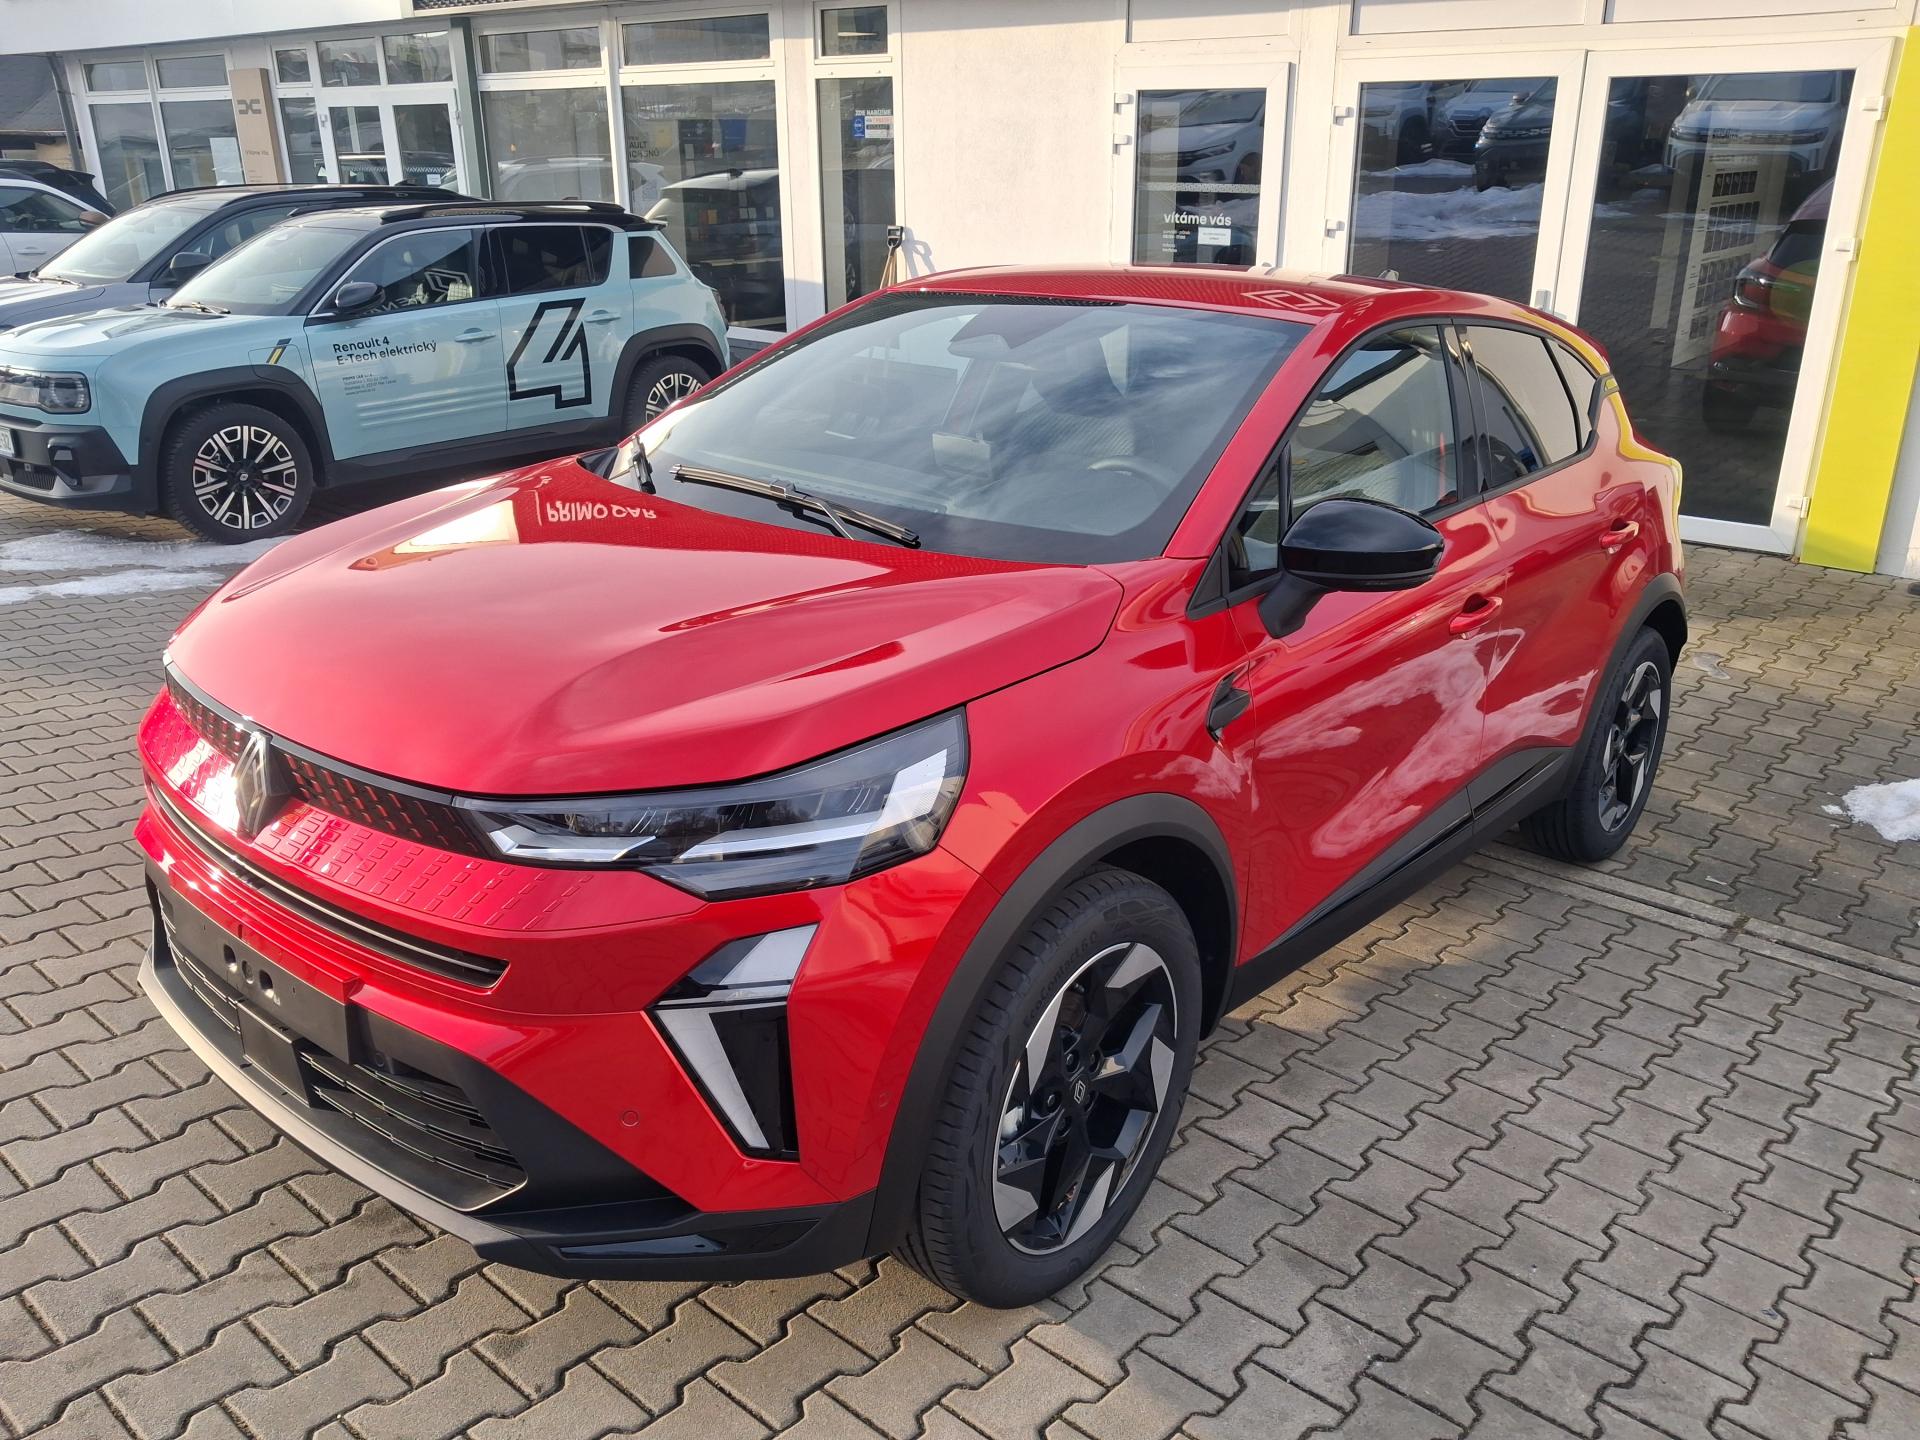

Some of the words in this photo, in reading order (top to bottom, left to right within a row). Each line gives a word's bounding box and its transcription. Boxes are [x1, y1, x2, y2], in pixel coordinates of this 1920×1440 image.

[629, 141, 647, 150] AULT
[1163, 211, 1207, 225] vítáme
[1209, 212, 1232, 226] vás
[332, 337, 381, 353] Renault
[382, 336, 390, 346] 4
[336, 349, 378, 366] E-Tech
[379, 340, 437, 359] elektrický
